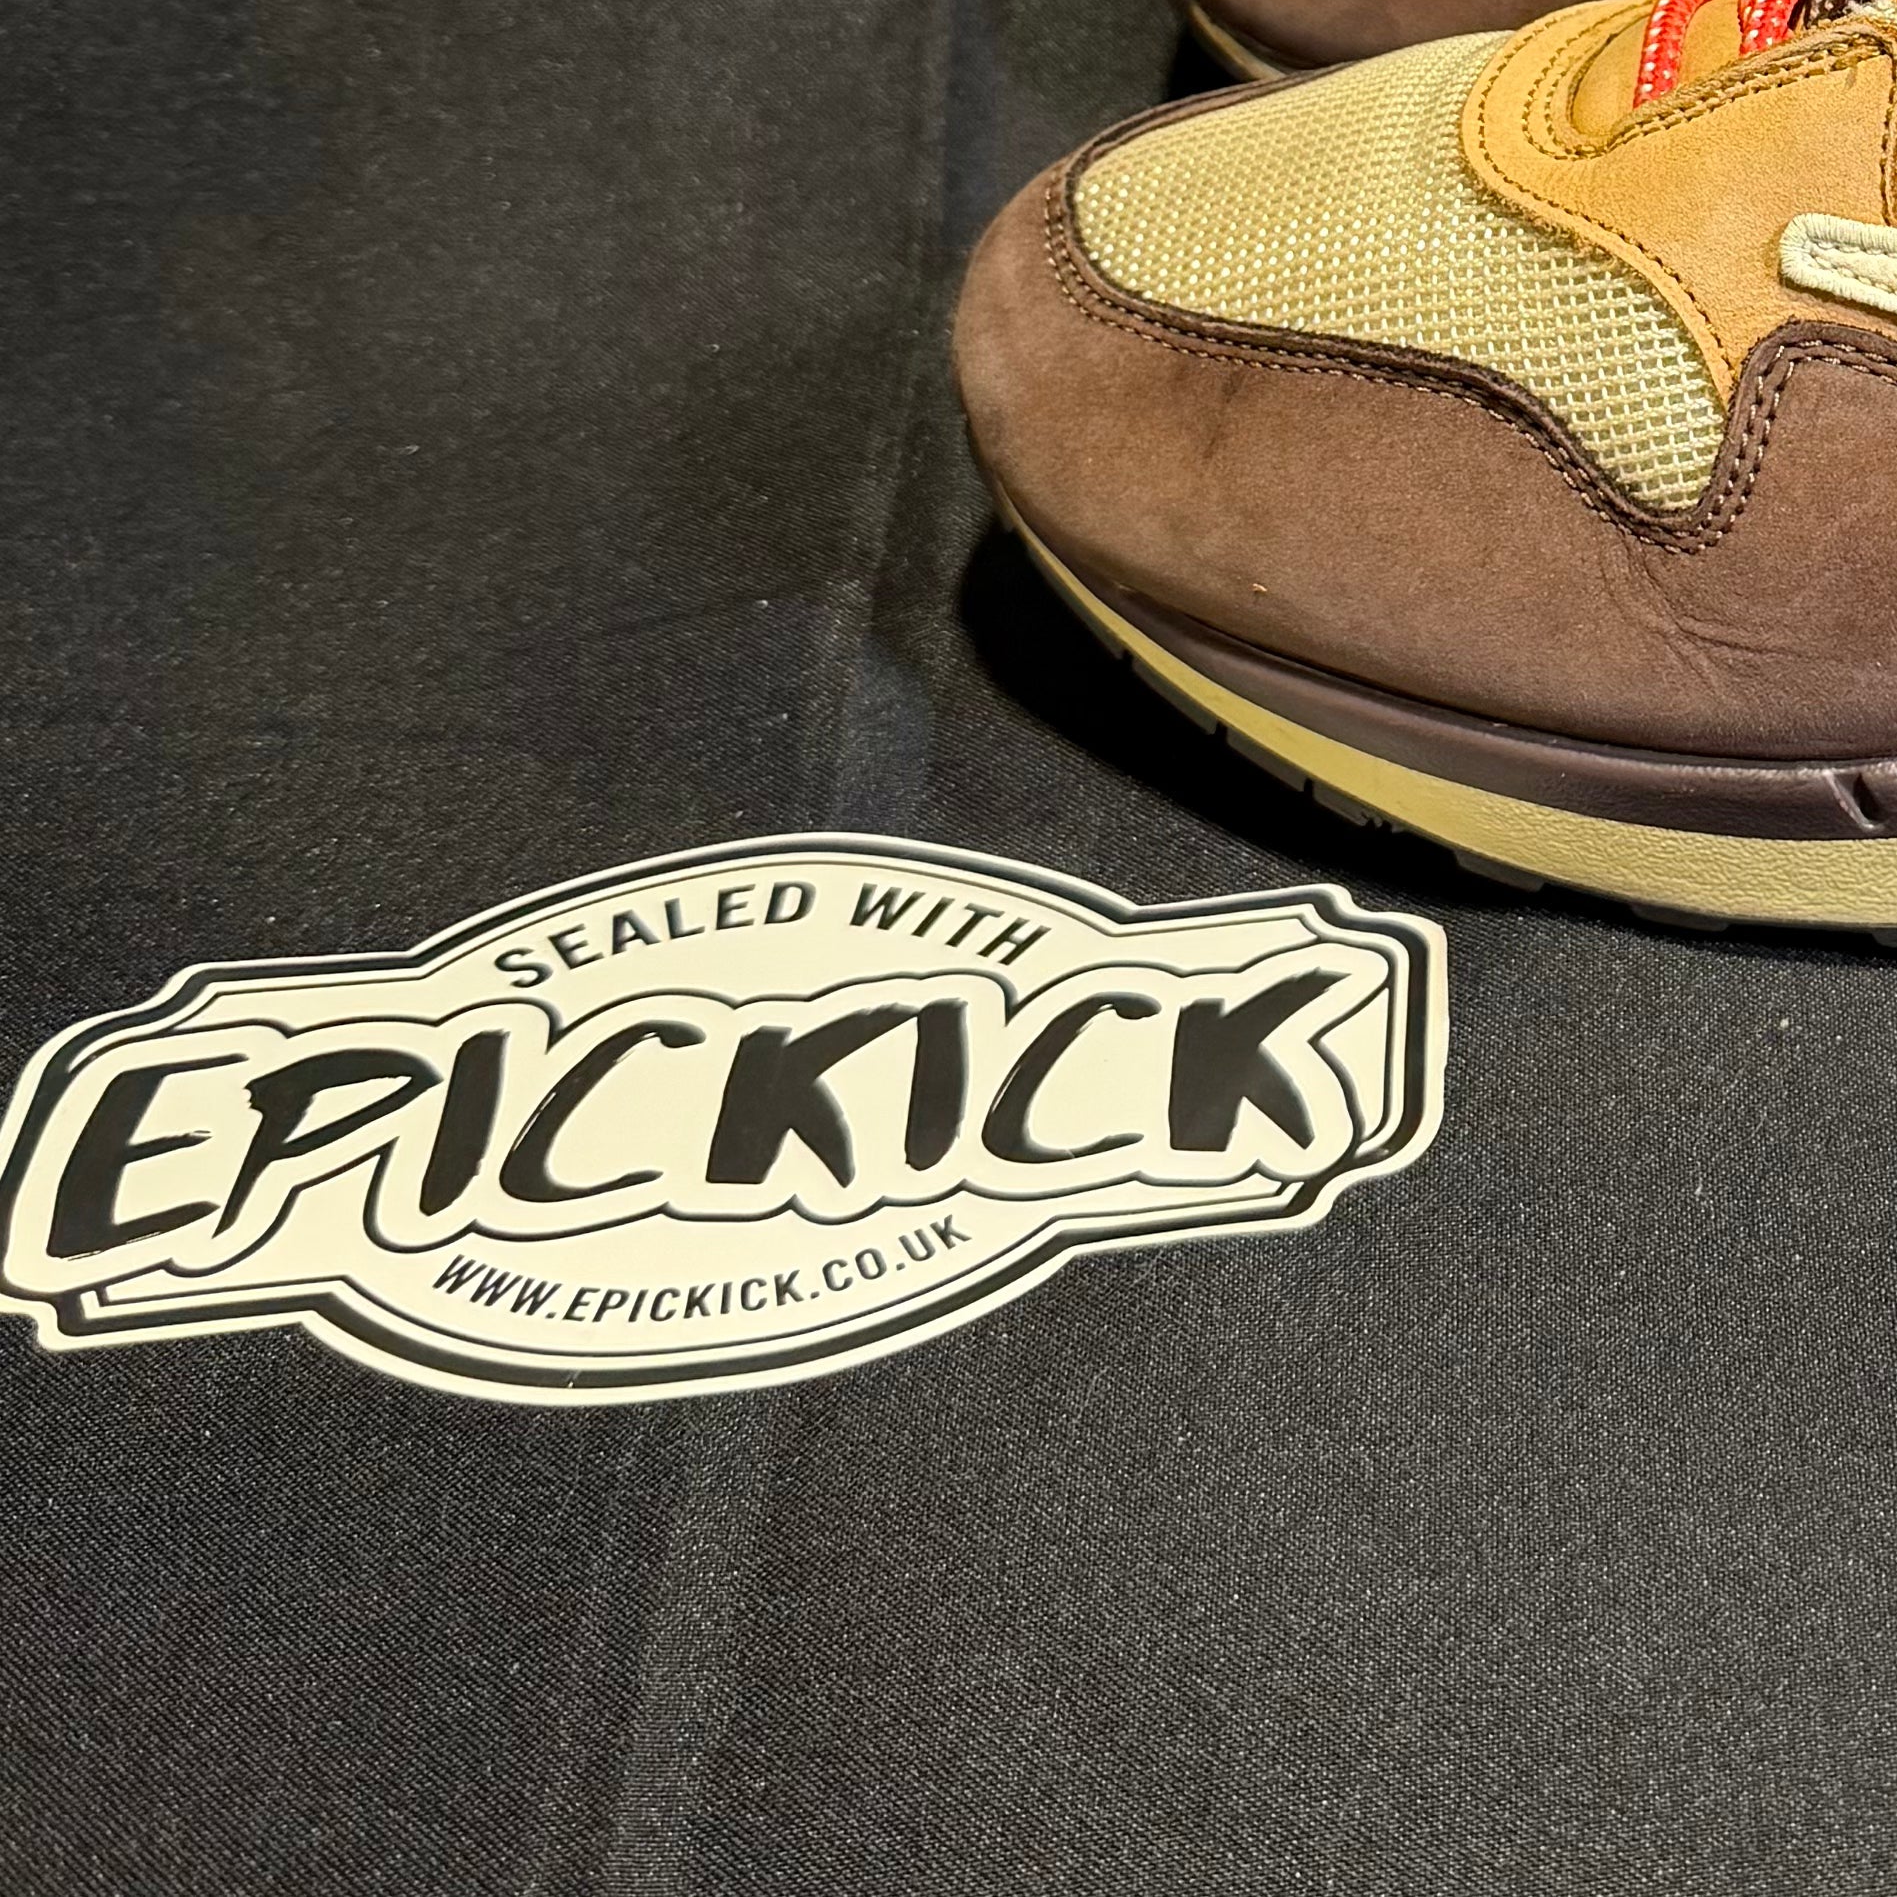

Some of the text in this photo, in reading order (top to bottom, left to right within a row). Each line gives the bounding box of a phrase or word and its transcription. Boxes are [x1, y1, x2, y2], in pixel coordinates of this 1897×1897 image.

[494, 882, 1050, 988] SEALED WITH
[47, 970, 1352, 1259] EPICKICK
[432, 1215, 972, 1324] WWW.EPICKICK.CO.UK
